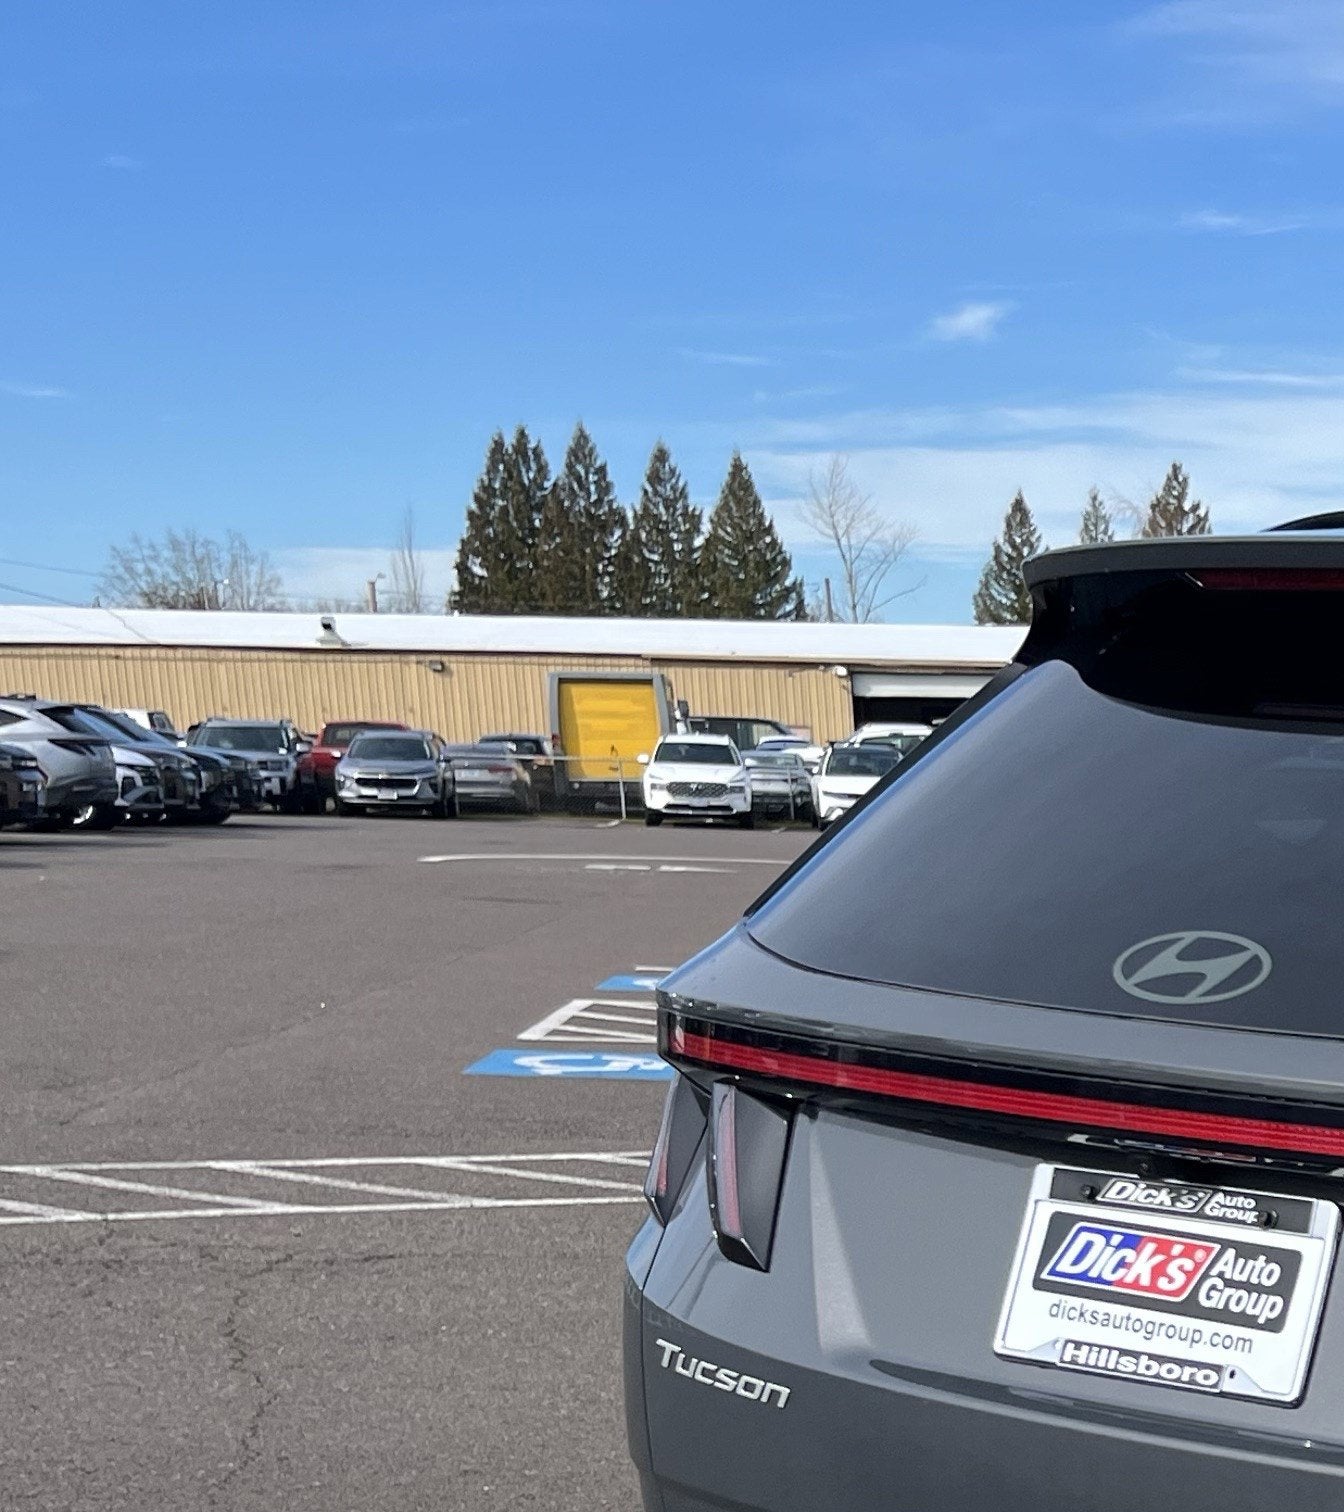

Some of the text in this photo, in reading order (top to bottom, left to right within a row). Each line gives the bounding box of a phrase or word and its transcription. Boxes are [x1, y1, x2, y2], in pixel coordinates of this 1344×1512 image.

[1105, 1180, 1205, 1210] Dick's
[1213, 1191, 1257, 1210] Auto
[1056, 1231, 1196, 1293] Dick's
[1209, 1247, 1282, 1287] Auto
[1198, 1277, 1284, 1325] Group
[1048, 1298, 1254, 1354] dicksautogroup.com
[655, 1338, 791, 1409] Tucson
[1060, 1342, 1221, 1387] Hillsboro
